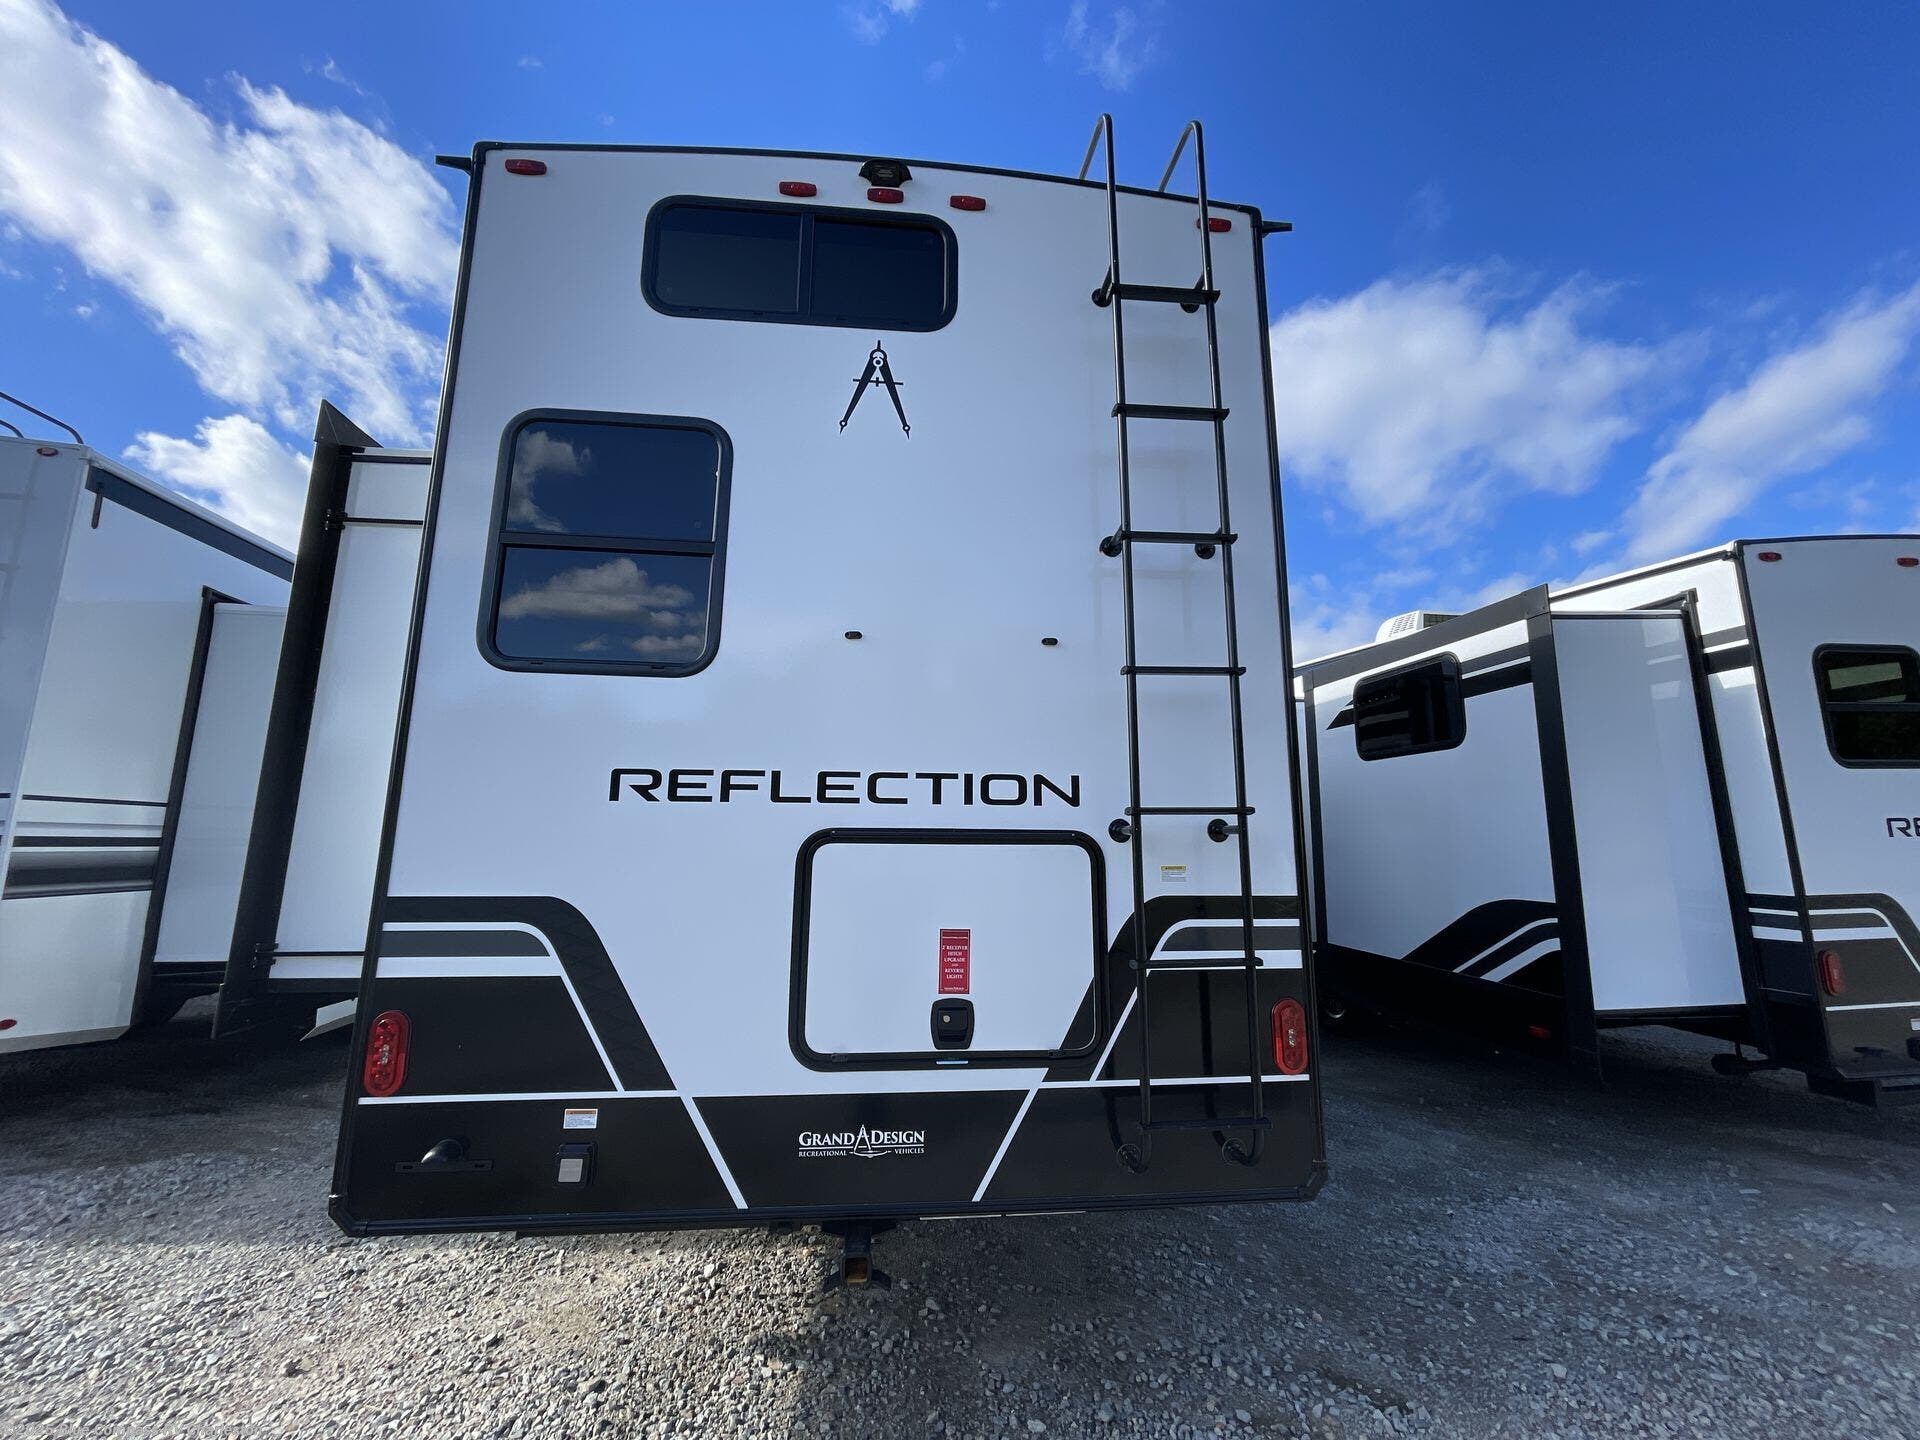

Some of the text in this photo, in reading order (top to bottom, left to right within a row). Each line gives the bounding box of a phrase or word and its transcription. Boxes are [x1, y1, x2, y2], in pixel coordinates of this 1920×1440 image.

[608, 768, 1081, 807] REFLECTION
[799, 1130, 925, 1146] GRAND DESIGN
[798, 1150, 847, 1158] RECREATIONAL
